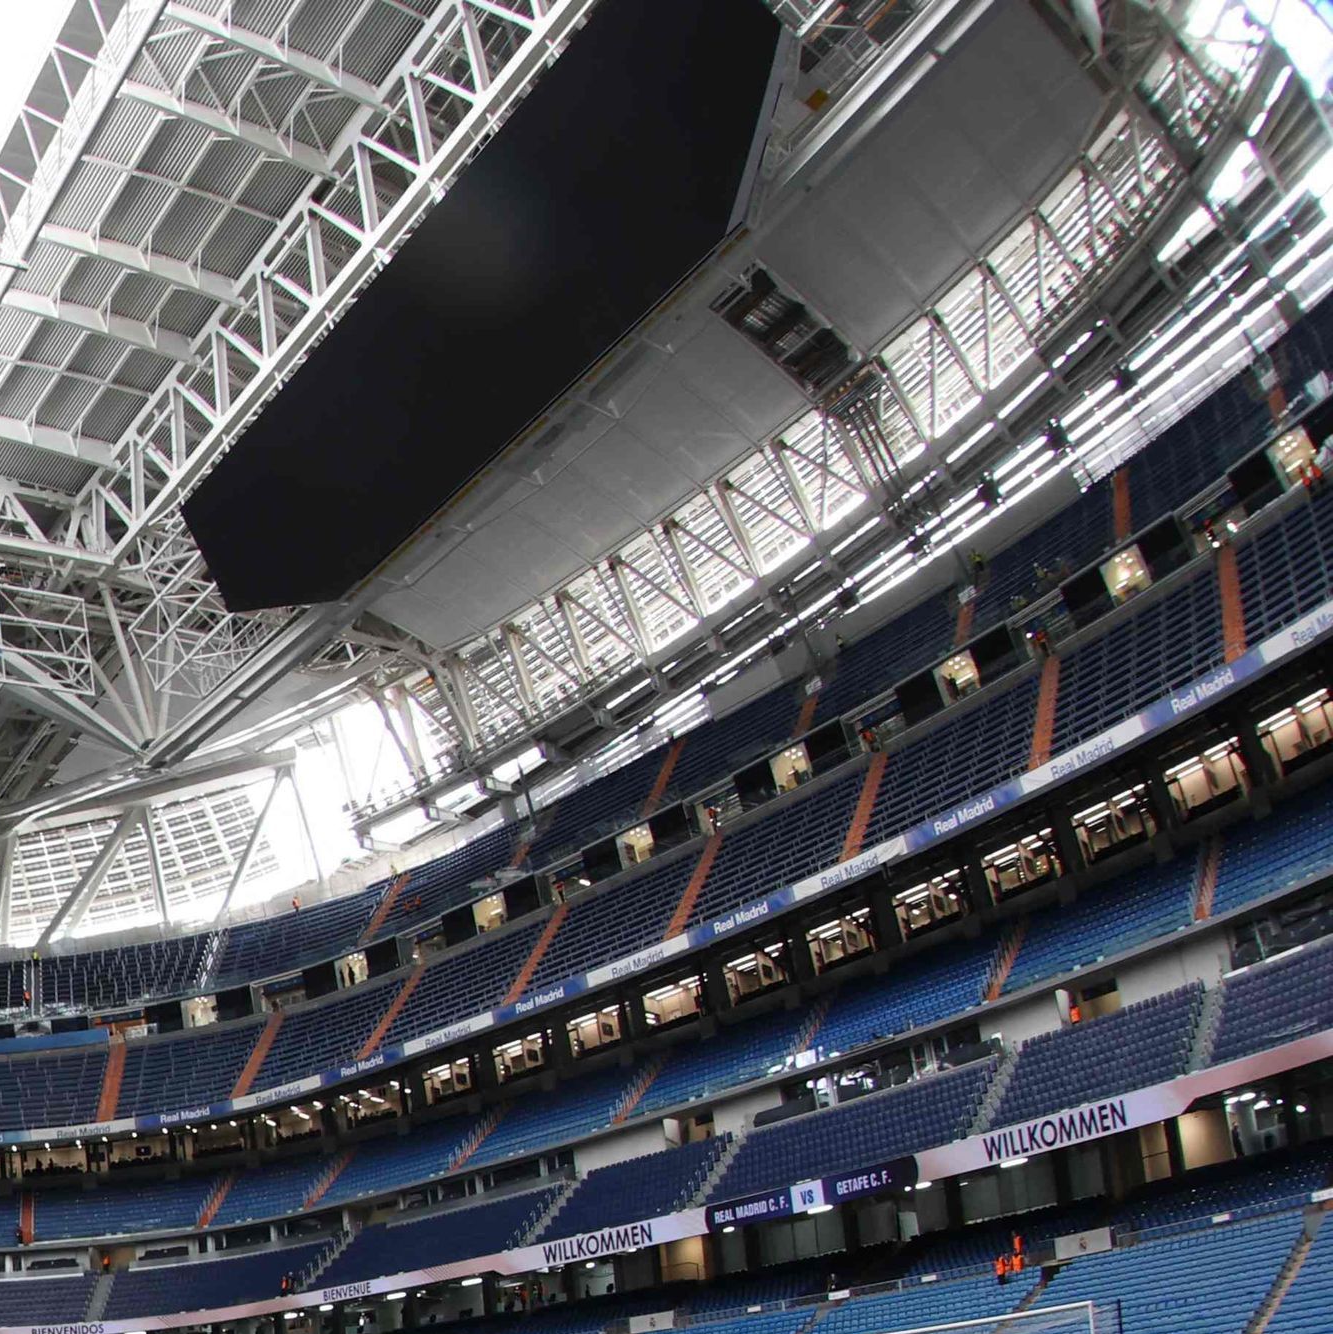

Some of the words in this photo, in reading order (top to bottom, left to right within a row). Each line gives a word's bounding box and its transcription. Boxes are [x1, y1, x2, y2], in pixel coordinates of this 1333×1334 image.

[1291, 623, 1317, 646] Real
[1171, 690, 1196, 713] Real
[1197, 669, 1234, 702] Madrid
[1050, 759, 1075, 780] Real
[1077, 738, 1114, 767] Madrid
[934, 815, 957, 835] Real
[958, 797, 994, 823] Madrid
[820, 872, 843, 889] Real
[844, 855, 878, 878] Madrid
[713, 917, 734, 934] Real
[735, 902, 768, 925] Madrid
[612, 962, 632, 978] Real
[633, 949, 664, 971] Madrid
[515, 1000, 533, 1014] Real
[534, 987, 564, 1007] Madrid
[425, 1035, 442, 1049] Real
[444, 1024, 471, 1044] Madrid
[340, 1064, 357, 1078] Real
[357, 1055, 383, 1073] Madrid
[256, 1092, 273, 1105] Real
[274, 1084, 301, 1100] Madrid
[160, 1112, 180, 1123] Real
[181, 1107, 210, 1120] Madrid
[983, 1099, 1128, 1162] WILLKOMMEN
[836, 1176, 869, 1196] GETAFE
[870, 1173, 880, 1187] C.
[882, 1170, 892, 1185] F.
[714, 1206, 735, 1224] REAL
[735, 1200, 767, 1220] MADRID
[768, 1199, 779, 1214] C.
[780, 1196, 789, 1211] F.
[800, 1189, 814, 1206] VS
[542, 1225, 653, 1265] WILLKOMMEN
[322, 1281, 371, 1302] BIENVENUE
